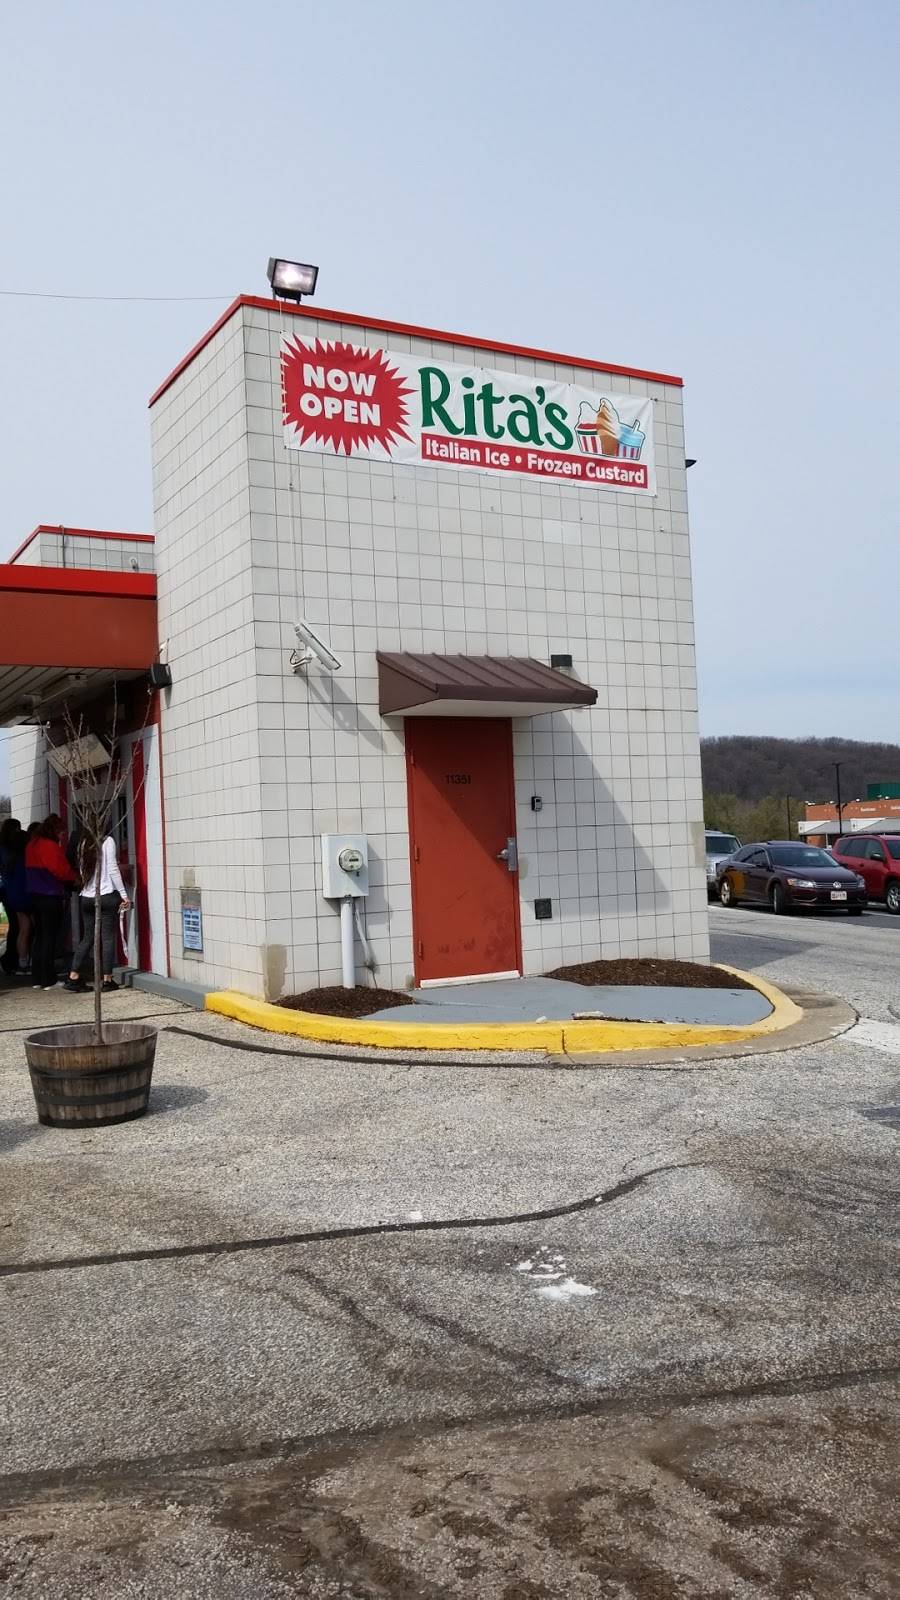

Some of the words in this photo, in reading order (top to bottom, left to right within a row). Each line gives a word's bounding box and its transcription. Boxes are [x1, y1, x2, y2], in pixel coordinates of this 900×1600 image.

[303, 363, 377, 396] NOW
[300, 393, 381, 427] OPEN
[418, 366, 574, 450] Rita's
[425, 439, 481, 463] Italian
[485, 445, 510, 466] Ice
[527, 453, 582, 476] Frozen
[586, 463, 645, 485] Custard
[445, 774, 471, 785] 11351
